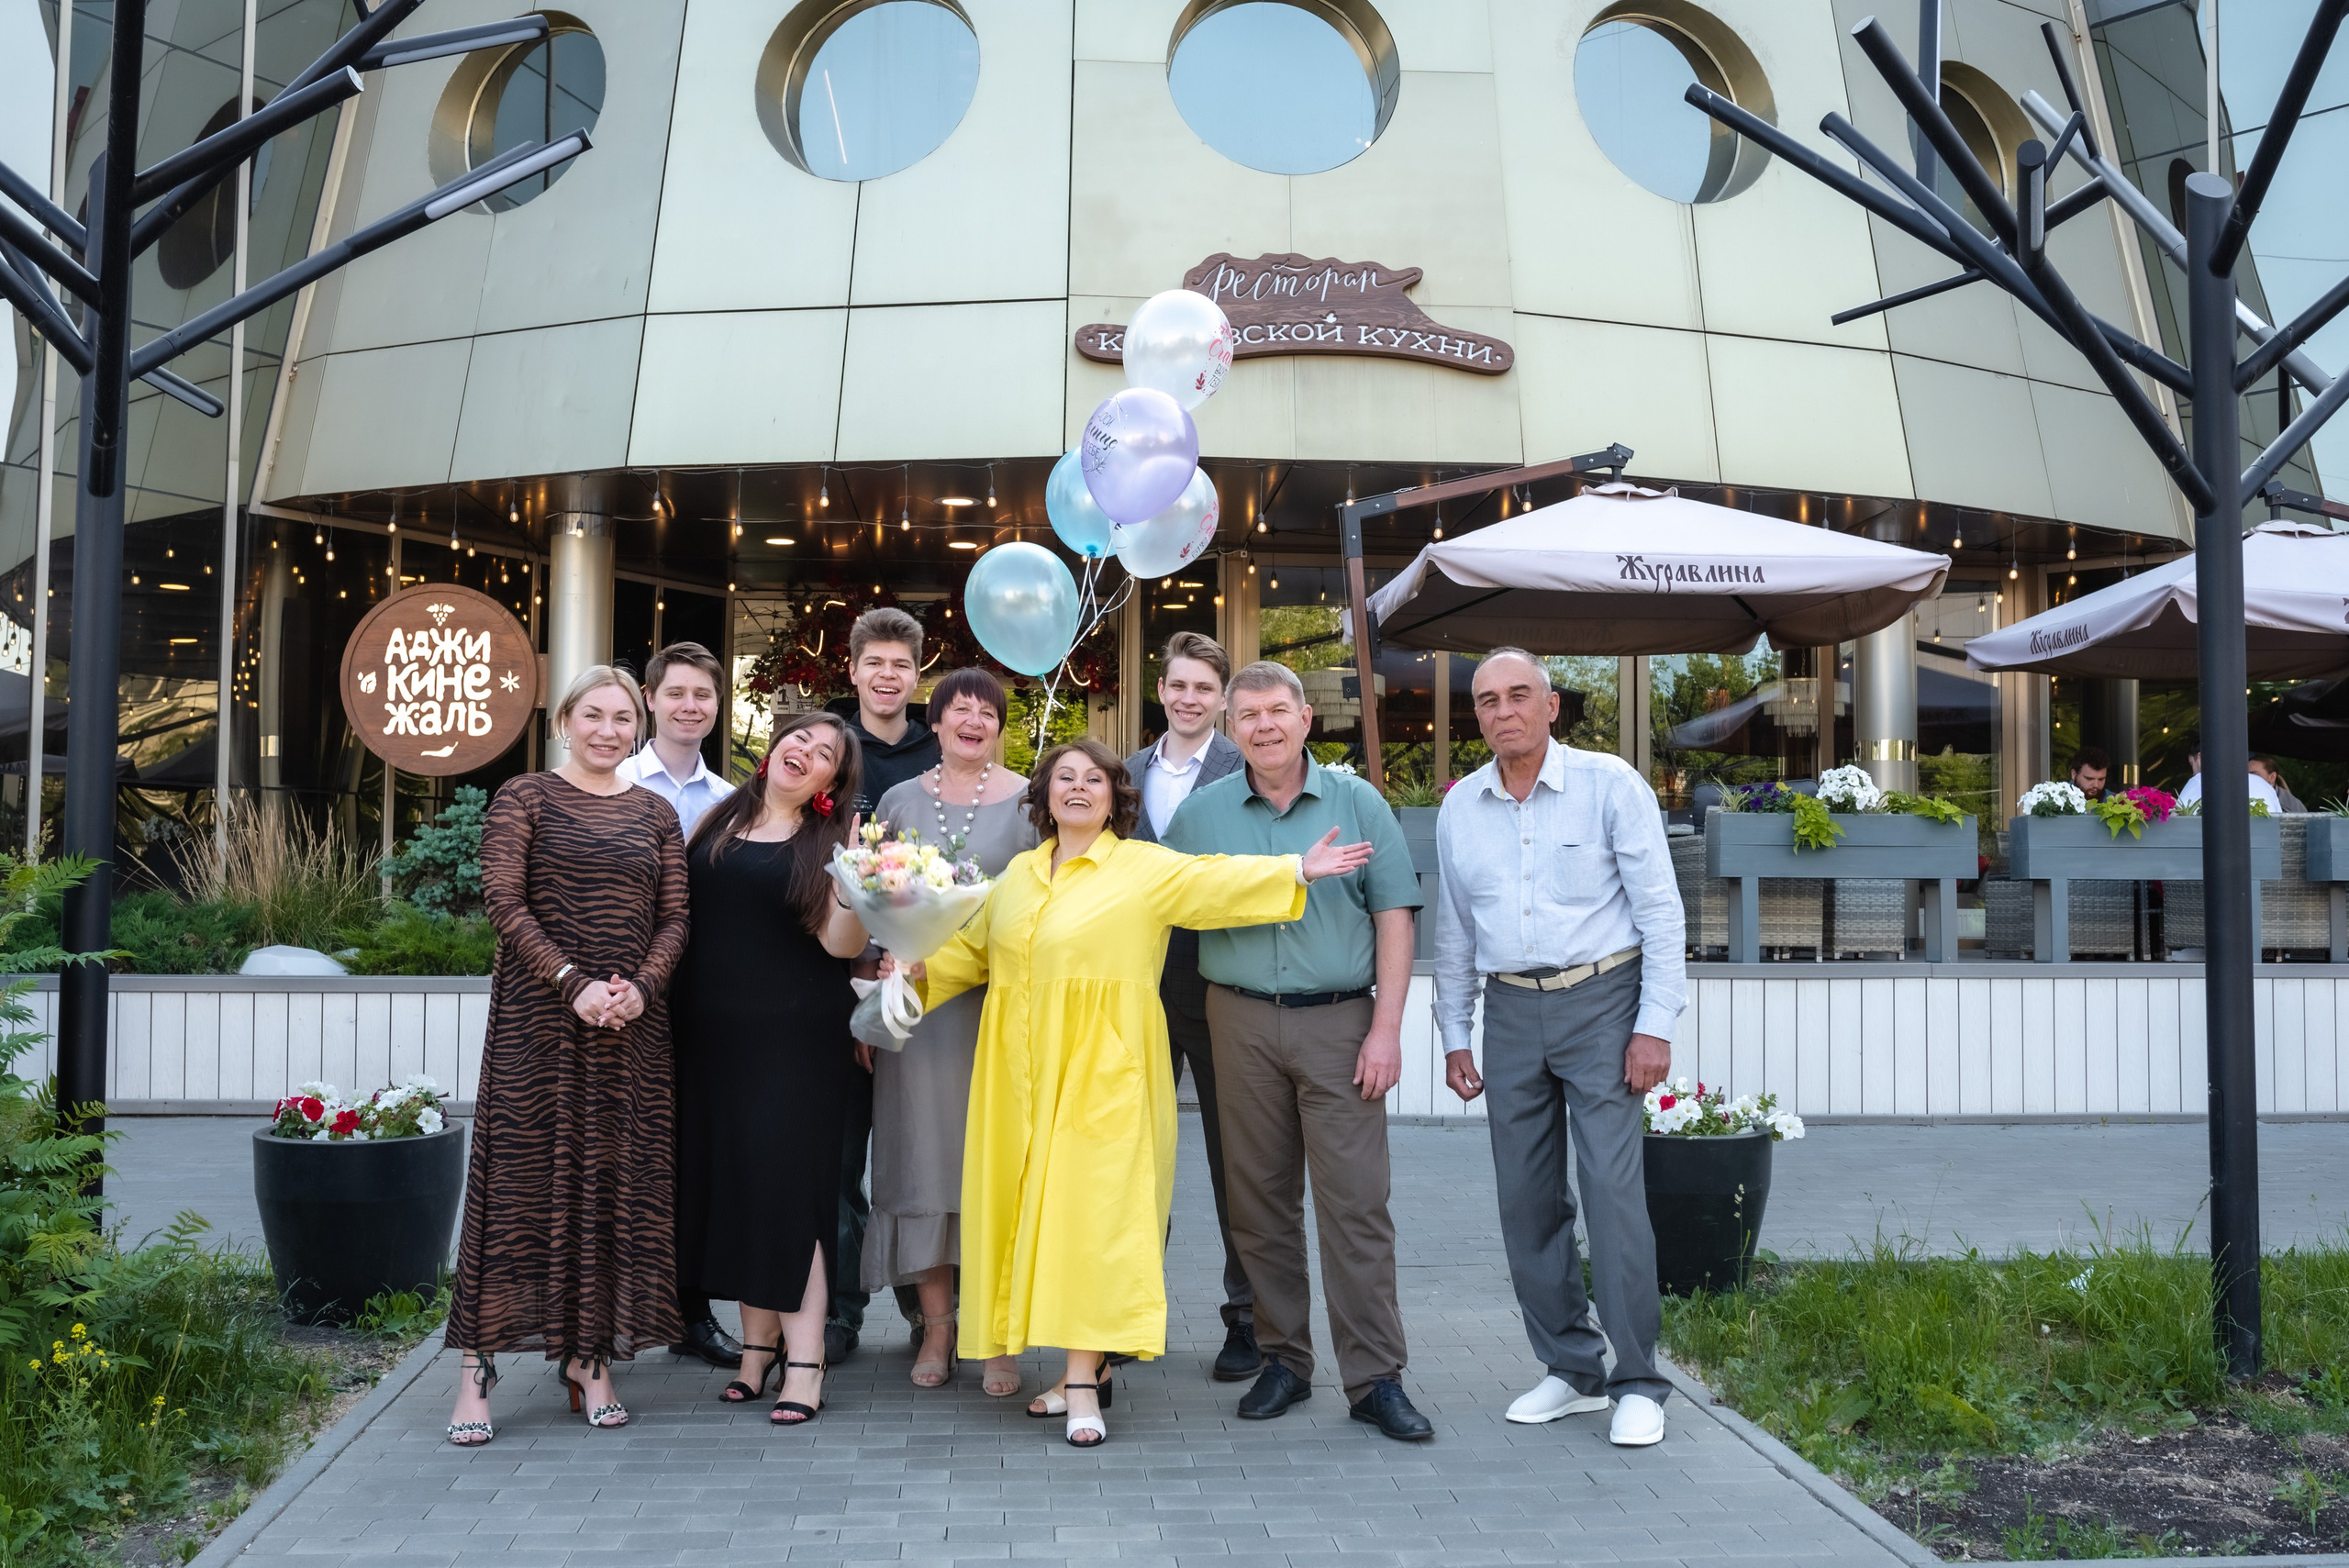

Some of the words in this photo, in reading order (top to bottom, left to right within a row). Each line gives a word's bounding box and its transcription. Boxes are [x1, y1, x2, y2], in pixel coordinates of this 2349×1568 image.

[1098, 313, 1344, 350] КЗСКОЙ
[1358, 325, 1492, 364] КУХНИ
[1615, 554, 1765, 594] Журавлина
